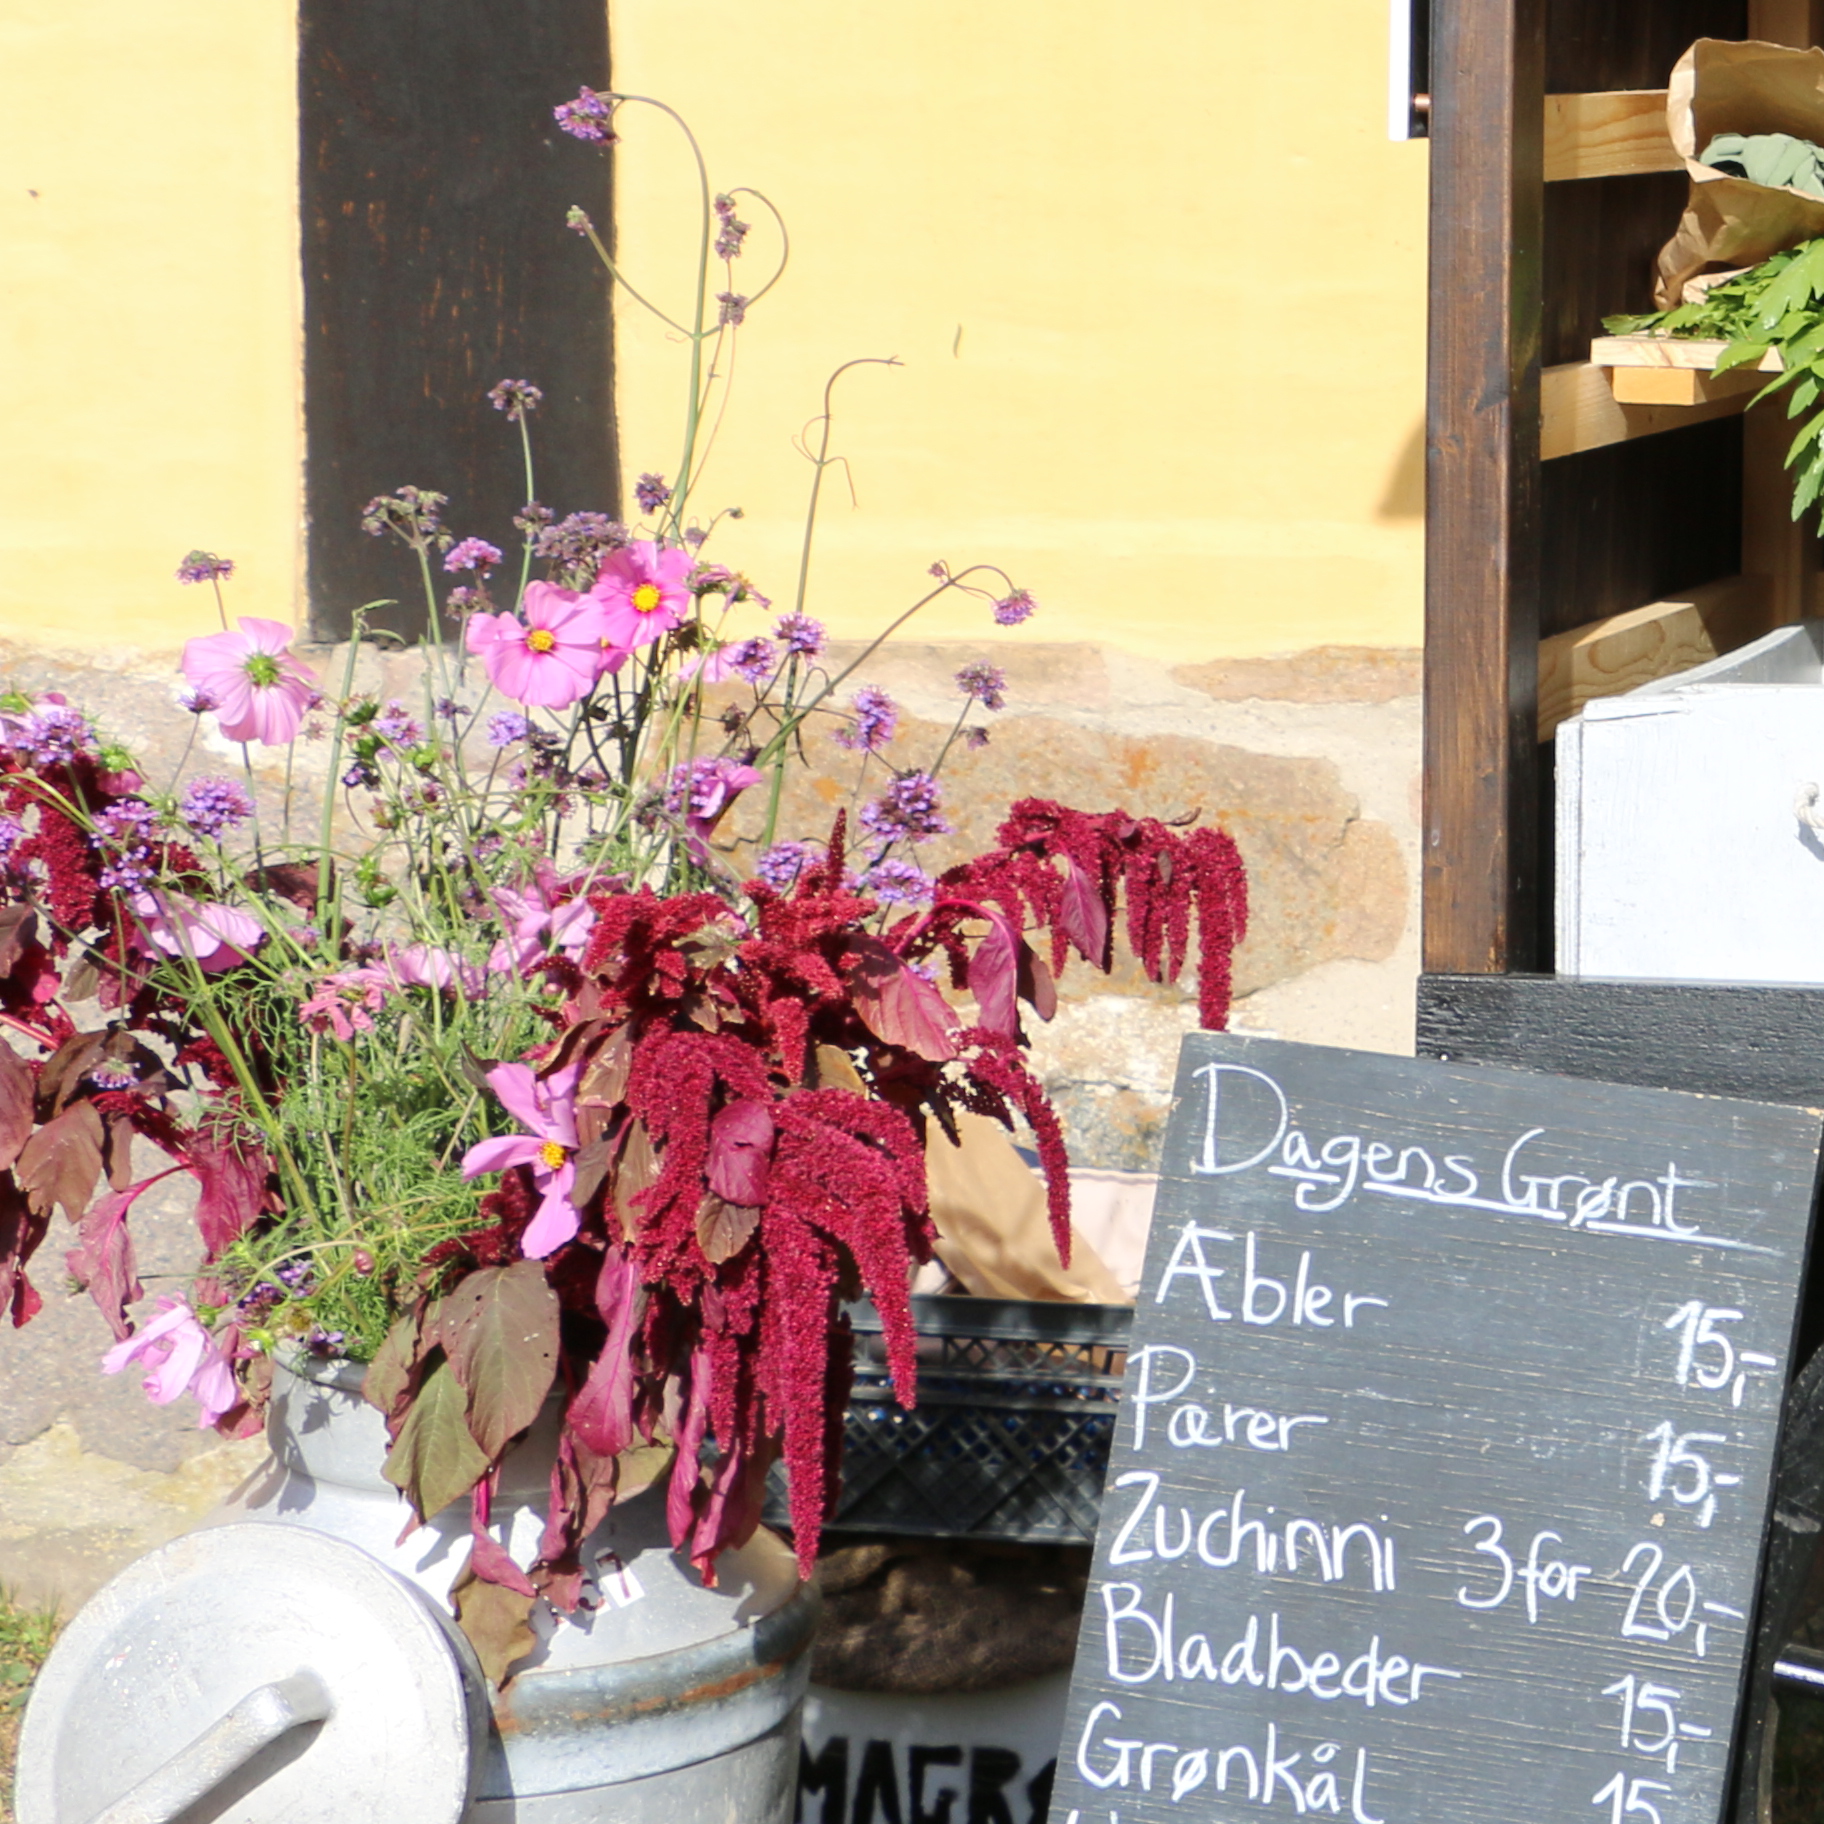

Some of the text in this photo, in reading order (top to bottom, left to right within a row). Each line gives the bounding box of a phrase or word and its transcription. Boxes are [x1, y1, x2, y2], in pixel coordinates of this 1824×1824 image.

[1190, 1061, 1718, 1236] Dagens Grønt
[1126, 1343, 1741, 1529] Pærer 15,-
[1664, 1299, 1777, 1407] 15,-
[1108, 1469, 1396, 1592] Zuchinni
[1621, 1542, 1745, 1657] 20,-
[1076, 1701, 1385, 1824] Grønkål
[1100, 1582, 1713, 1774] Bladbeder 15,-
